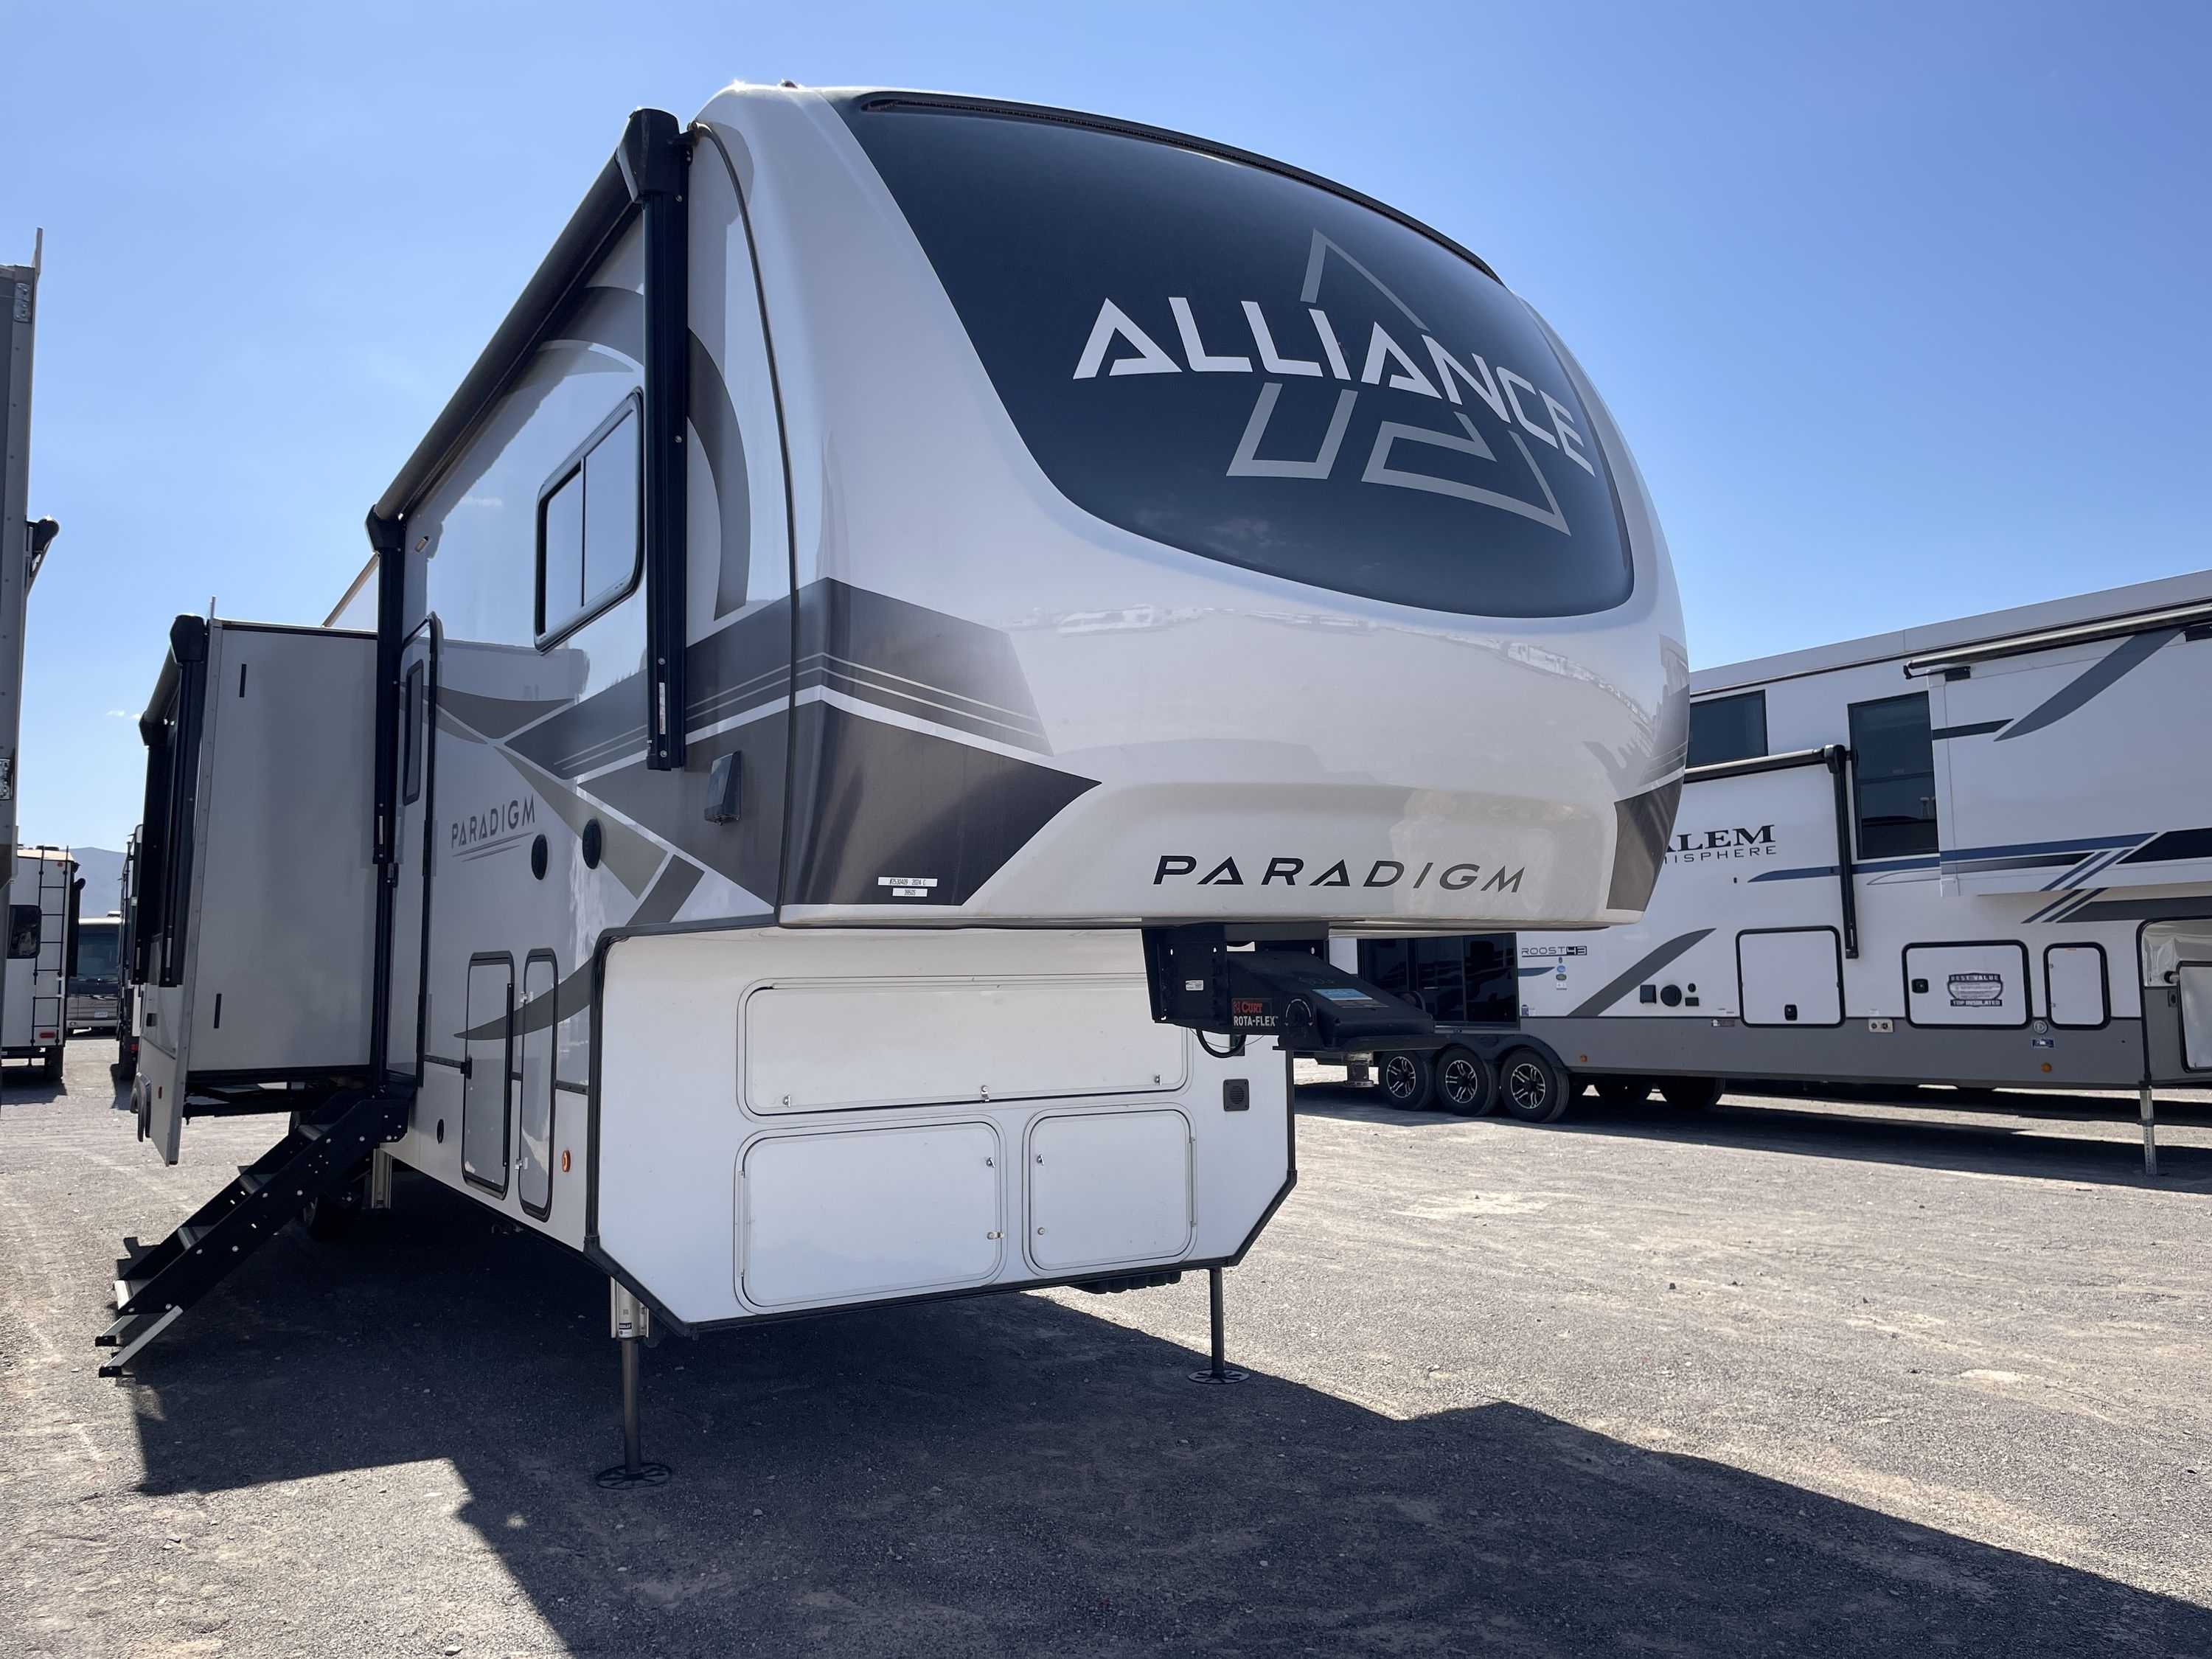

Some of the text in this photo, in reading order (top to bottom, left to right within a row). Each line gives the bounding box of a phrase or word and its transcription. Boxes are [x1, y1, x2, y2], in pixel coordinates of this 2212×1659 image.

[1072, 296, 1596, 477] ALLIANCE
[451, 794, 535, 849] PARADIGM
[1152, 855, 1526, 894] PARADIGM
